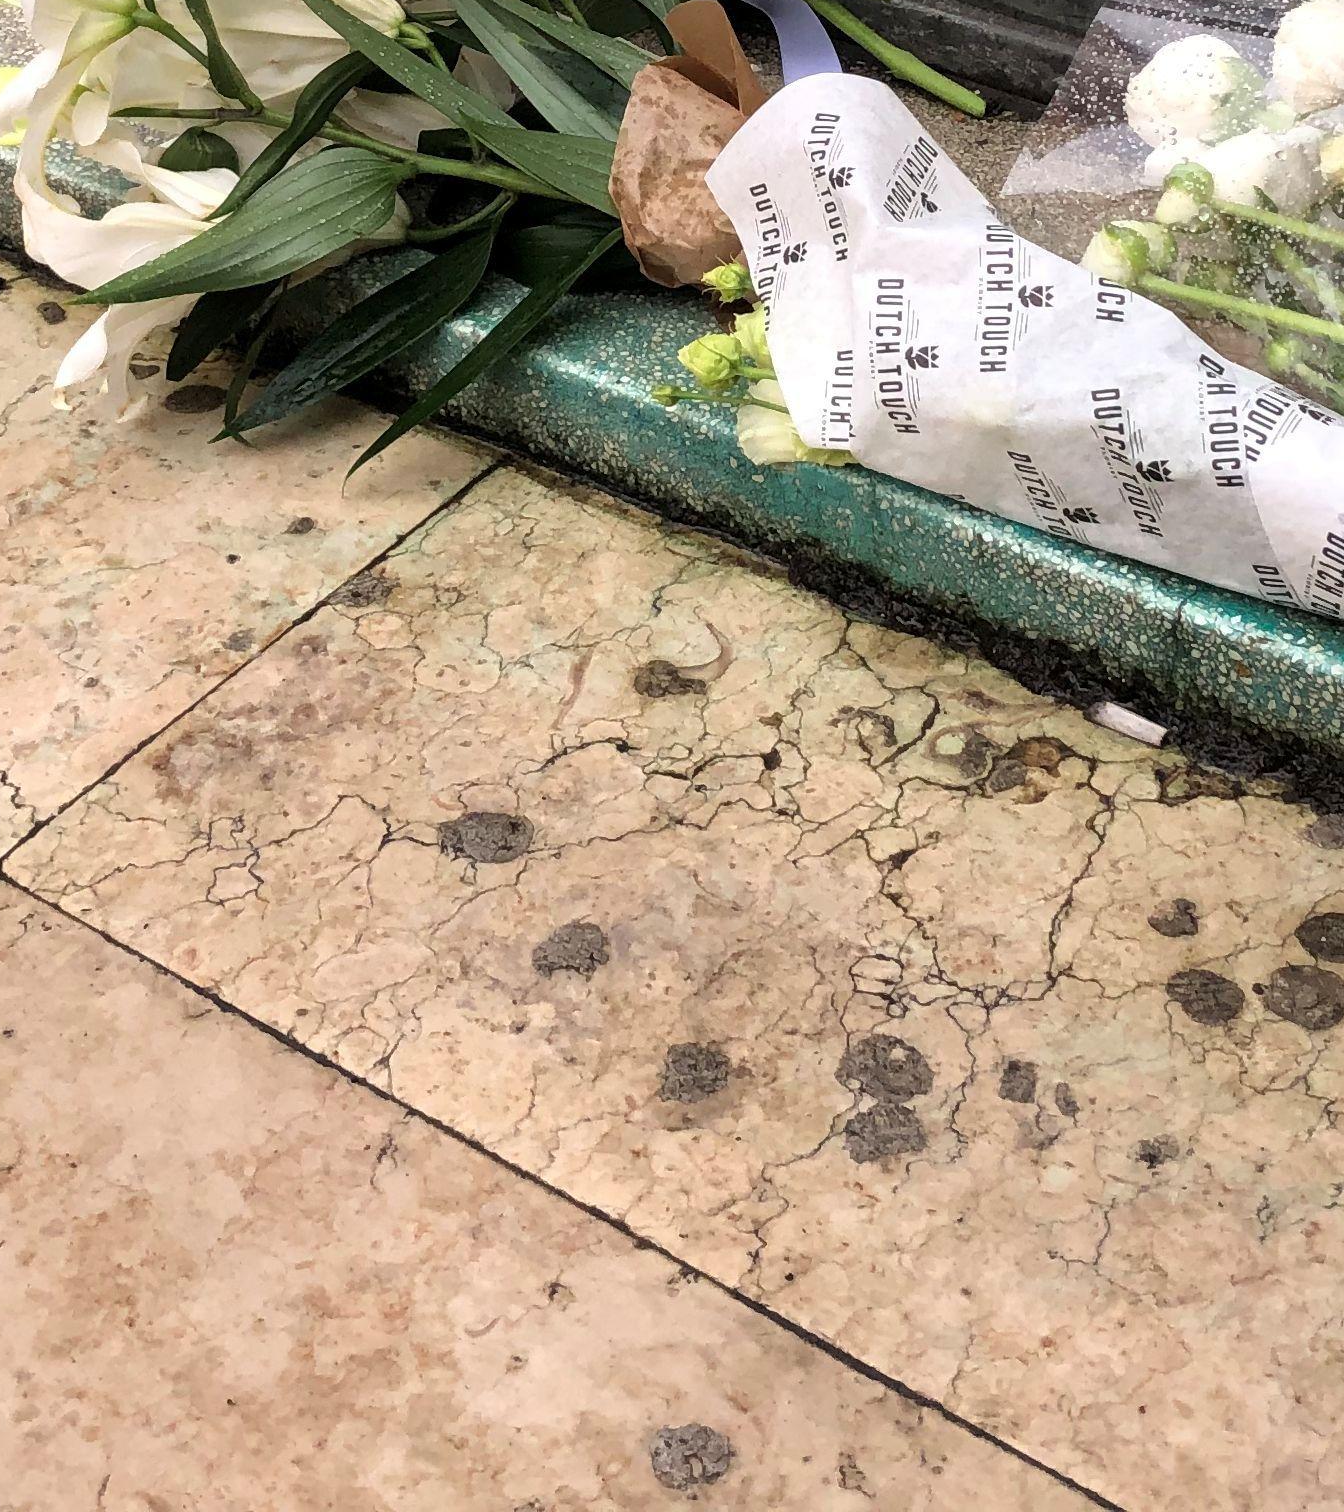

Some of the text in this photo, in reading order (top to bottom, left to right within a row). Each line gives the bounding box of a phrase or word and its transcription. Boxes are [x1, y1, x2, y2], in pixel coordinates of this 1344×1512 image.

[807, 112, 841, 179] DUTCH
[883, 136, 939, 223] DUTCH TOUCH
[749, 182, 782, 257] DUTCH
[819, 186, 849, 262] TOUCH
[875, 278, 921, 434] DUTCH TOUCH
[979, 302, 1013, 373] TOUCH
[1007, 450, 1058, 511] DUTCH
[1090, 388, 1164, 538] DUTCH TOUCH
[1208, 405, 1245, 488] TOUCH
